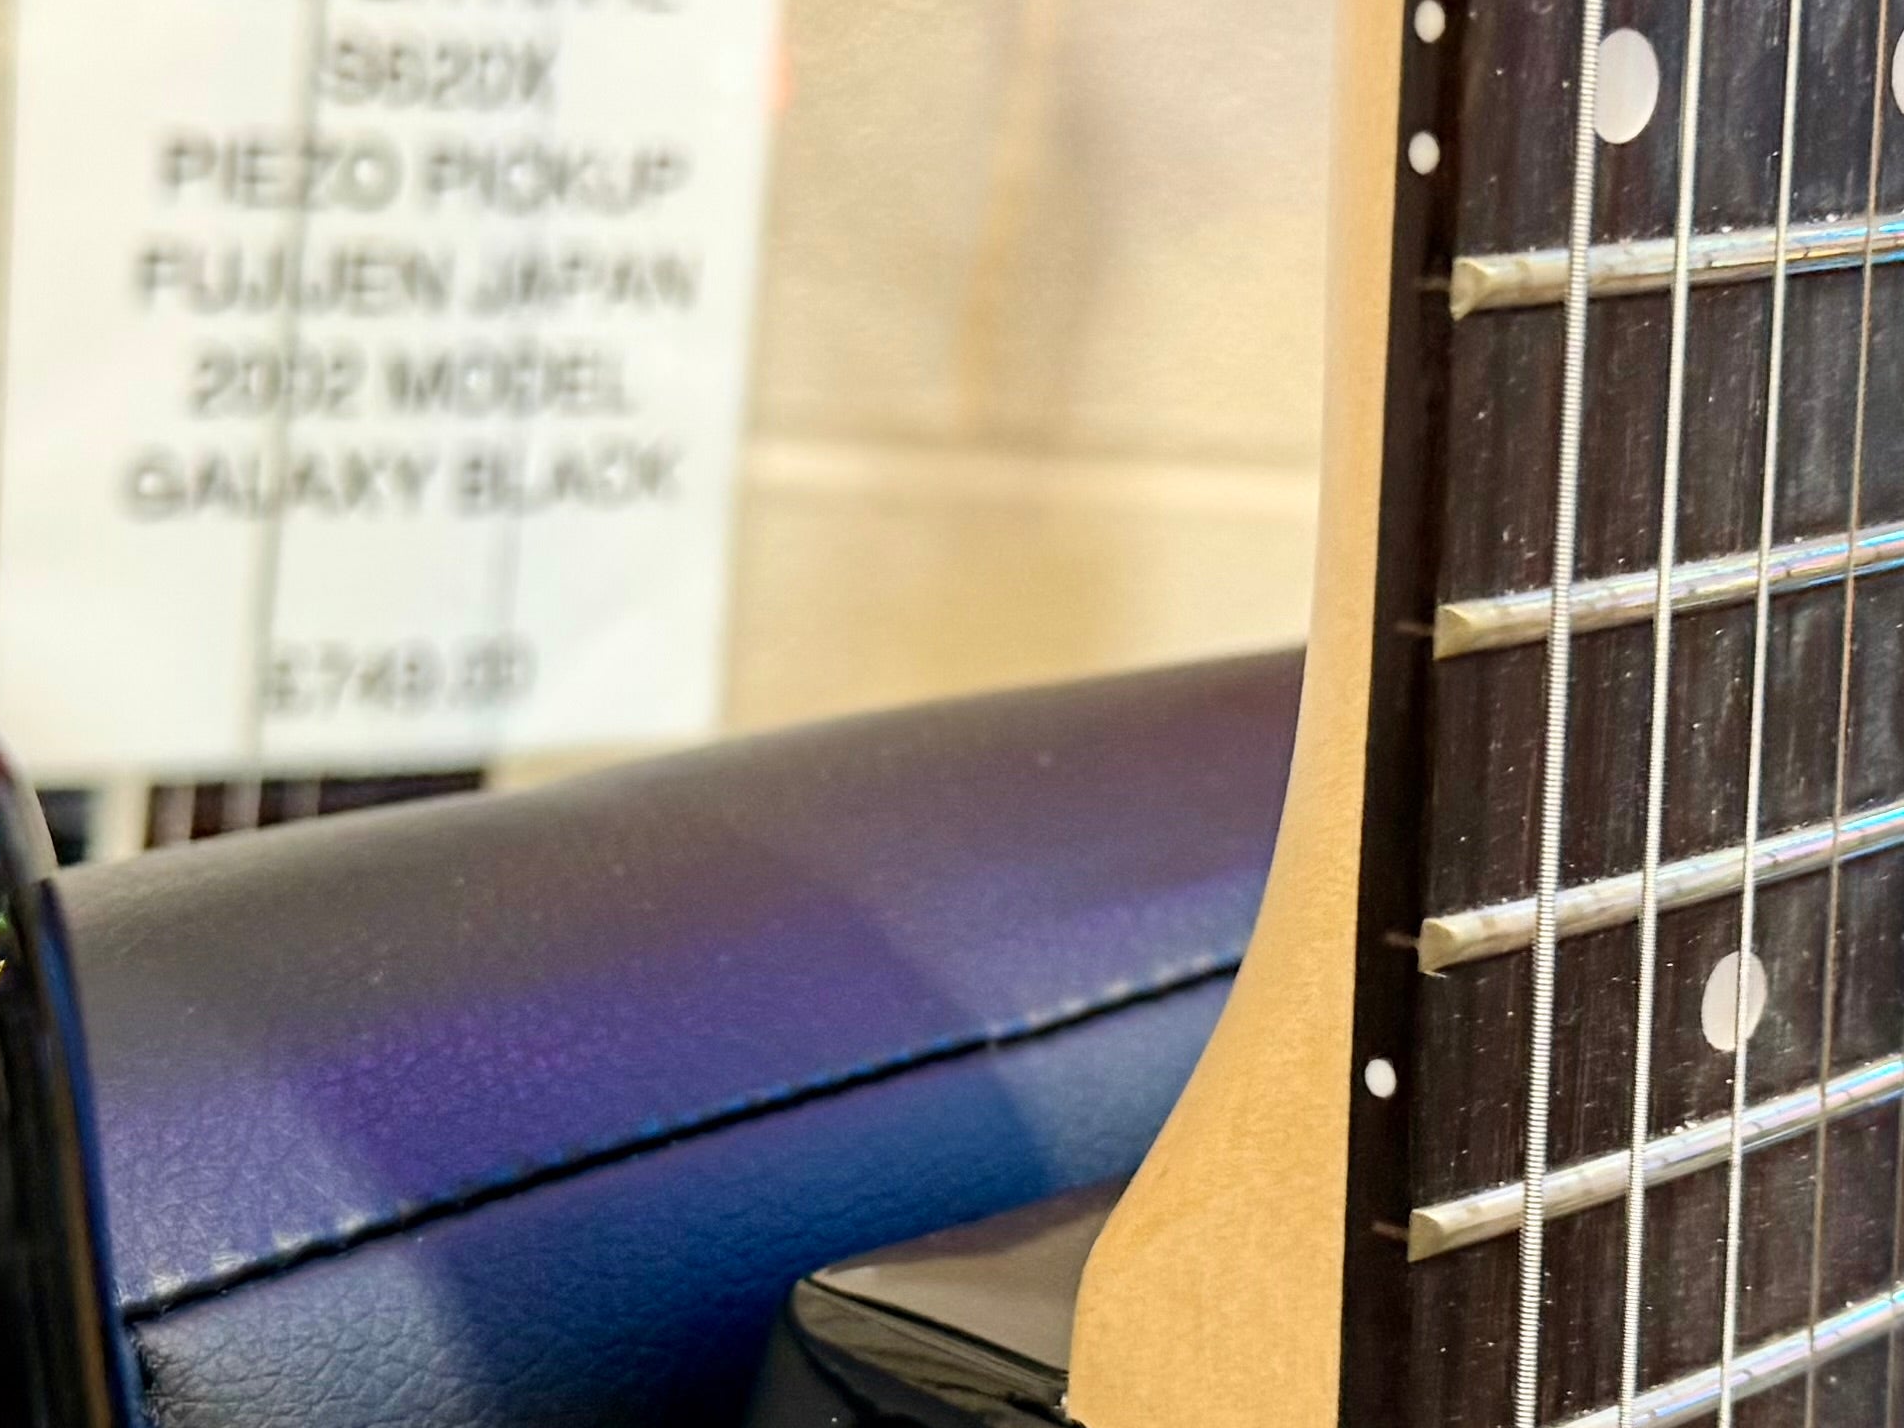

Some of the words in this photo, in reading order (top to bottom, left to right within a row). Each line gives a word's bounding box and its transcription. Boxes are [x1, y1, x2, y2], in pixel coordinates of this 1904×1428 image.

[156, 134, 404, 214] PIEZO
[420, 140, 692, 218] PICKUP
[470, 250, 702, 314] JAPAN
[186, 342, 368, 420] 2002
[382, 344, 638, 420] MODEL
[120, 448, 436, 520] GALAXY
[452, 444, 684, 518] BLACK
